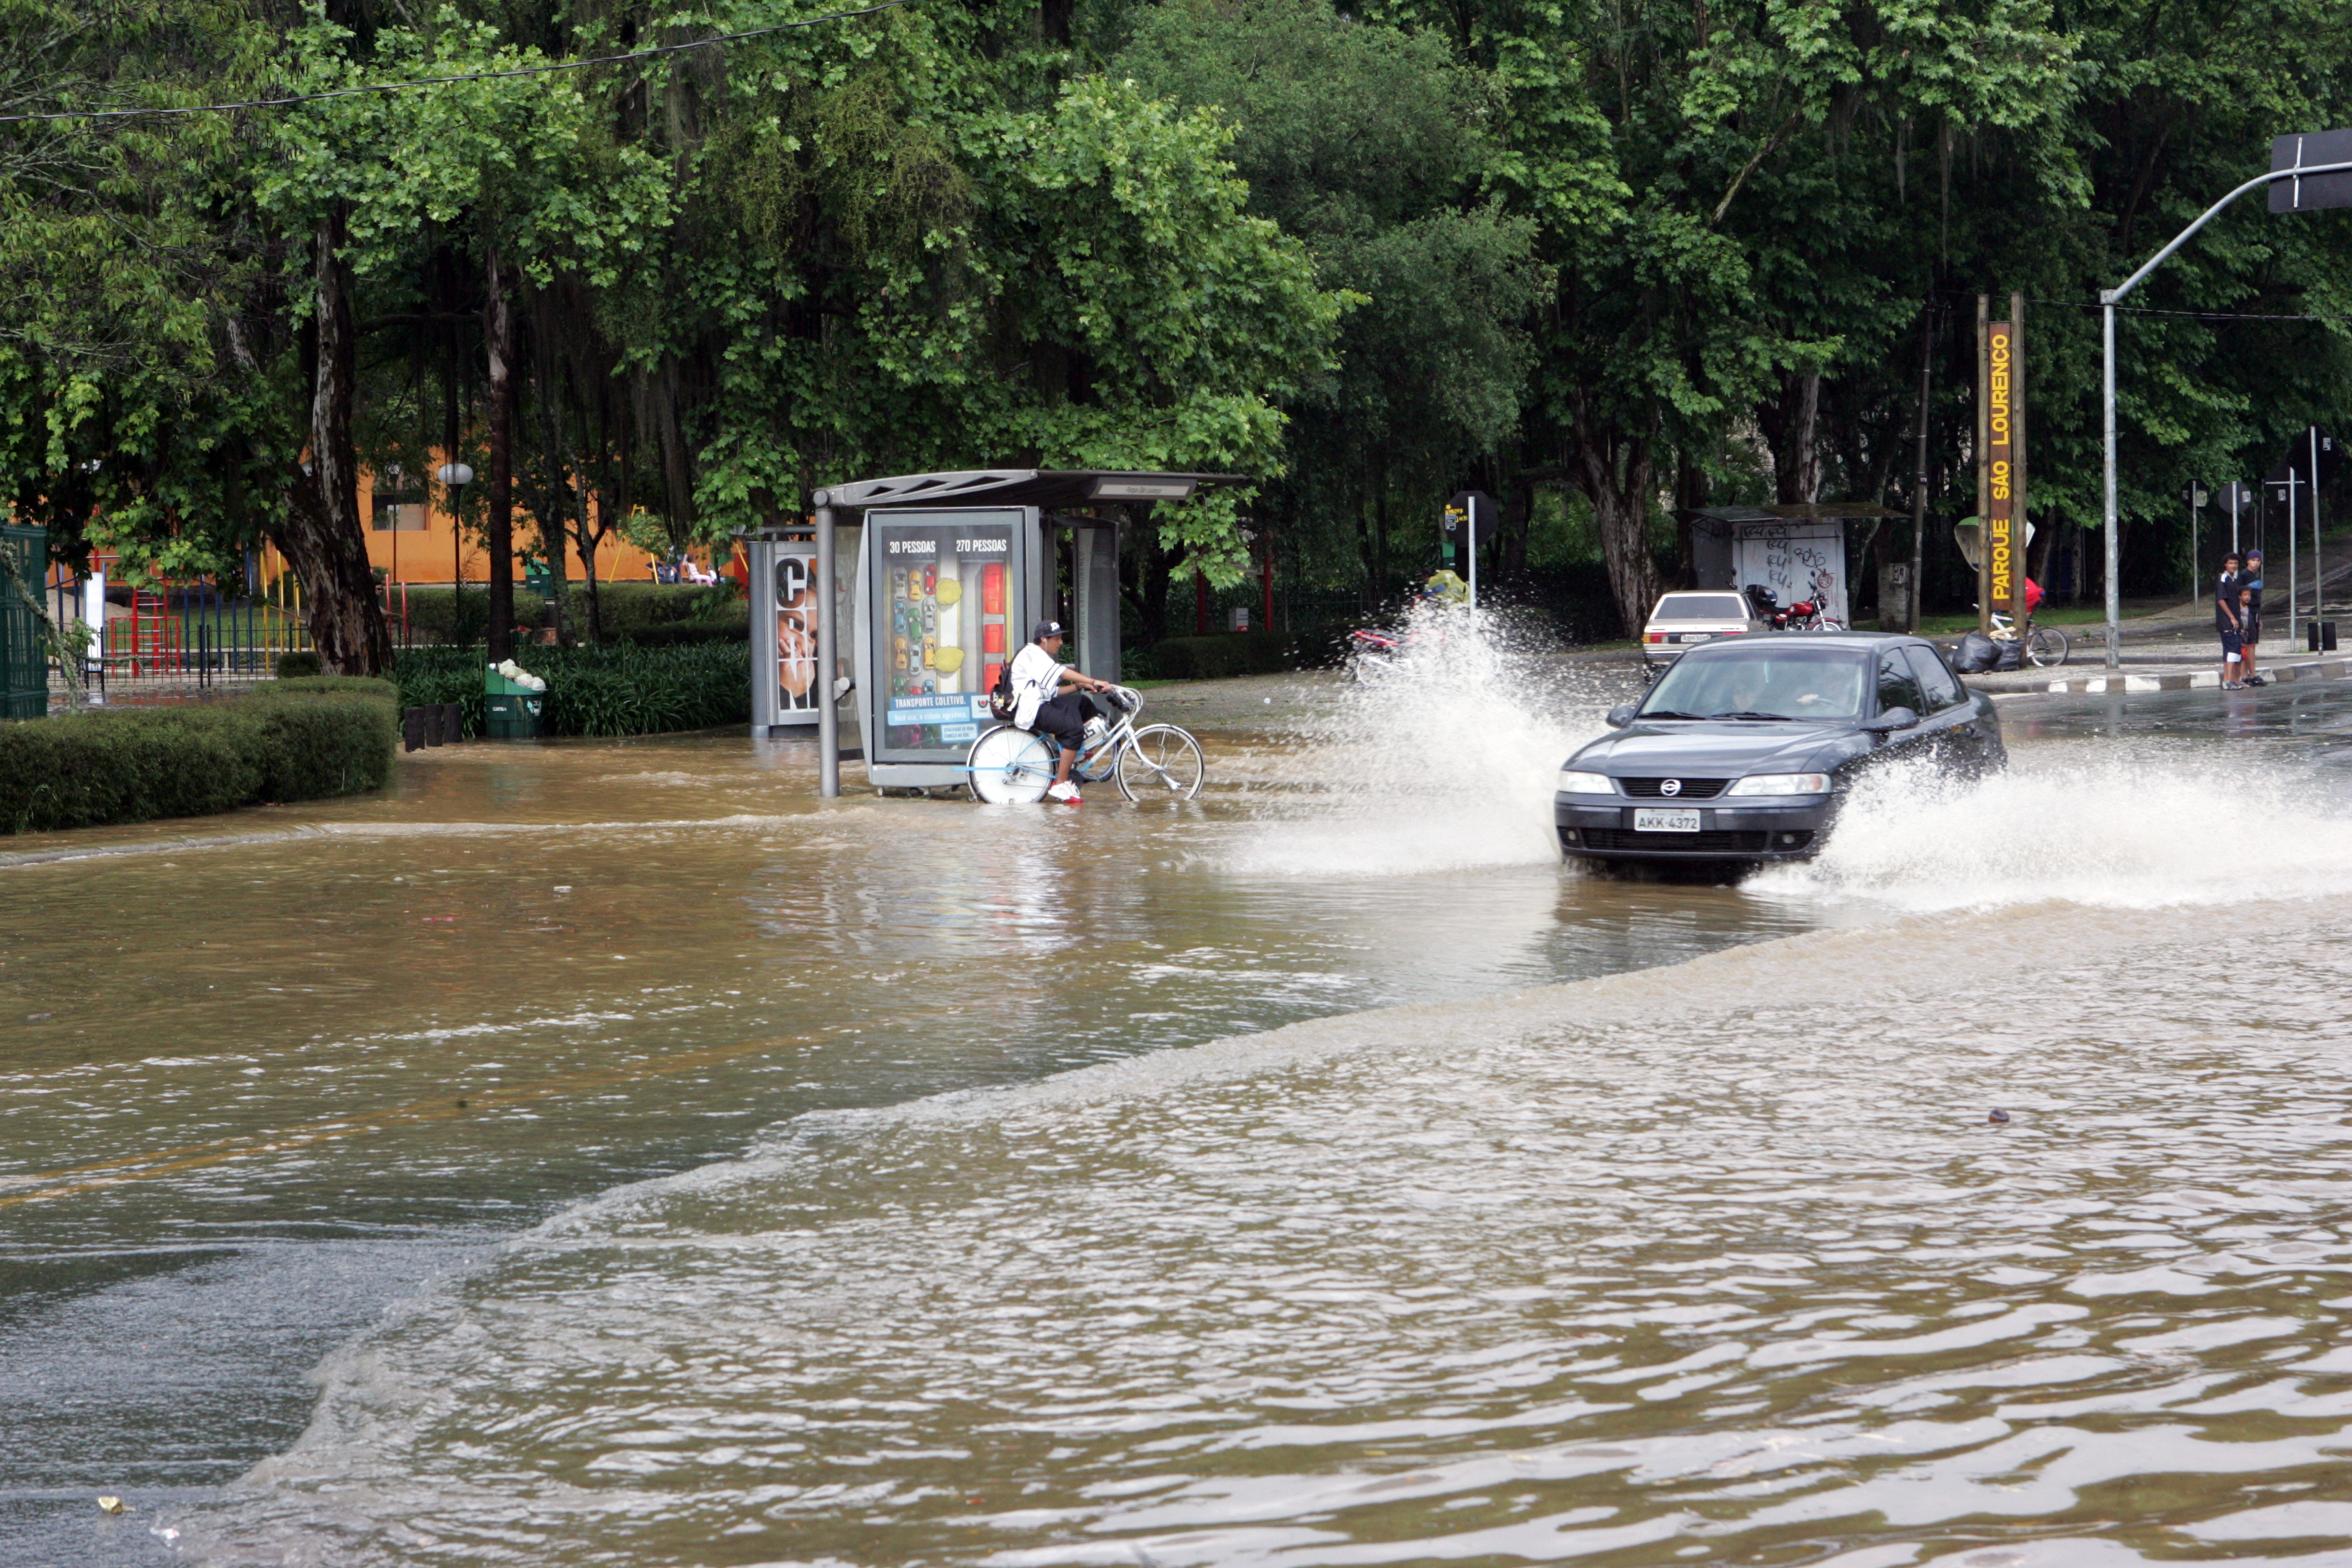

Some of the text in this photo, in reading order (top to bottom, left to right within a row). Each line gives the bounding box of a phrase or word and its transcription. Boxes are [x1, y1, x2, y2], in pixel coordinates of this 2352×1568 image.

[1992, 334, 2010, 445] LOURENÇO
[889, 541, 936, 554] 30 PESSOAS
[957, 539, 1007, 552] 270 PESSOAS
[1993, 519, 2010, 599] PARQUE
[895, 695, 966, 708] TRANSPORTE COLETIVO.
[924, 712, 940, 720] cidade
